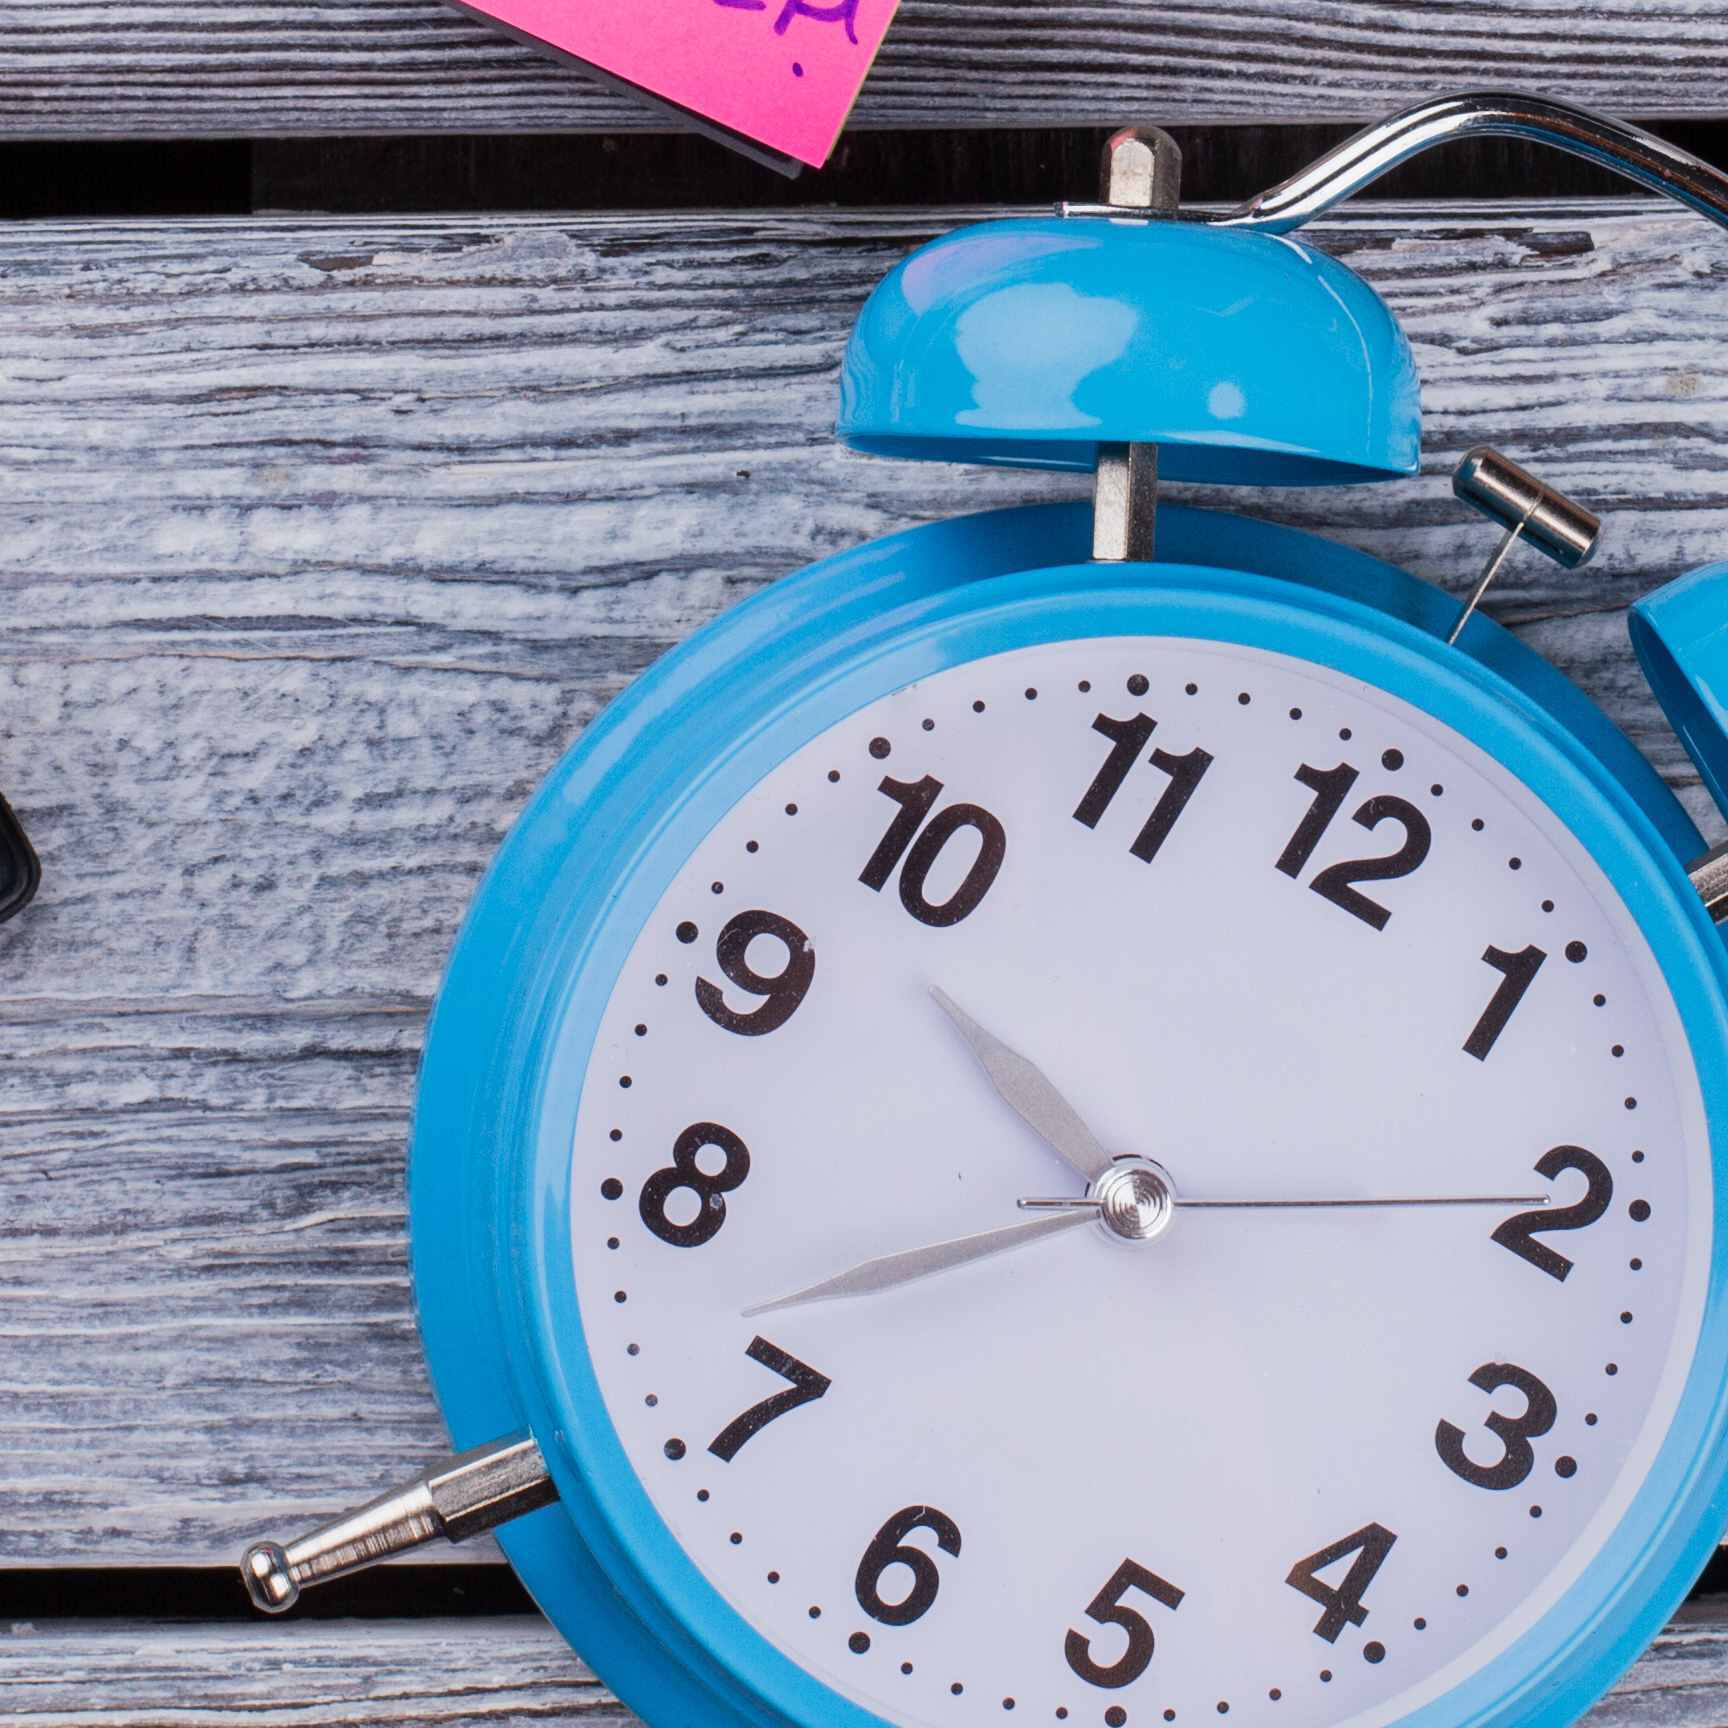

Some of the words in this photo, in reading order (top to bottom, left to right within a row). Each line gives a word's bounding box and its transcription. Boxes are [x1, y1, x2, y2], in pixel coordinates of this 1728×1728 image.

[858, 774, 1006, 928] 10
[1072, 712, 1214, 864] 11
[1275, 762, 1432, 931] 12
[695, 909, 816, 1037] 9
[1462, 944, 1547, 1062] 1
[638, 1122, 751, 1248] 8
[1490, 1145, 1613, 1283] 2
[707, 1335, 832, 1463] 7
[1435, 1361, 1557, 1491] 3
[855, 1505, 962, 1627] 6
[1064, 1558, 1185, 1689] 5
[1286, 1521, 1397, 1644] 4
